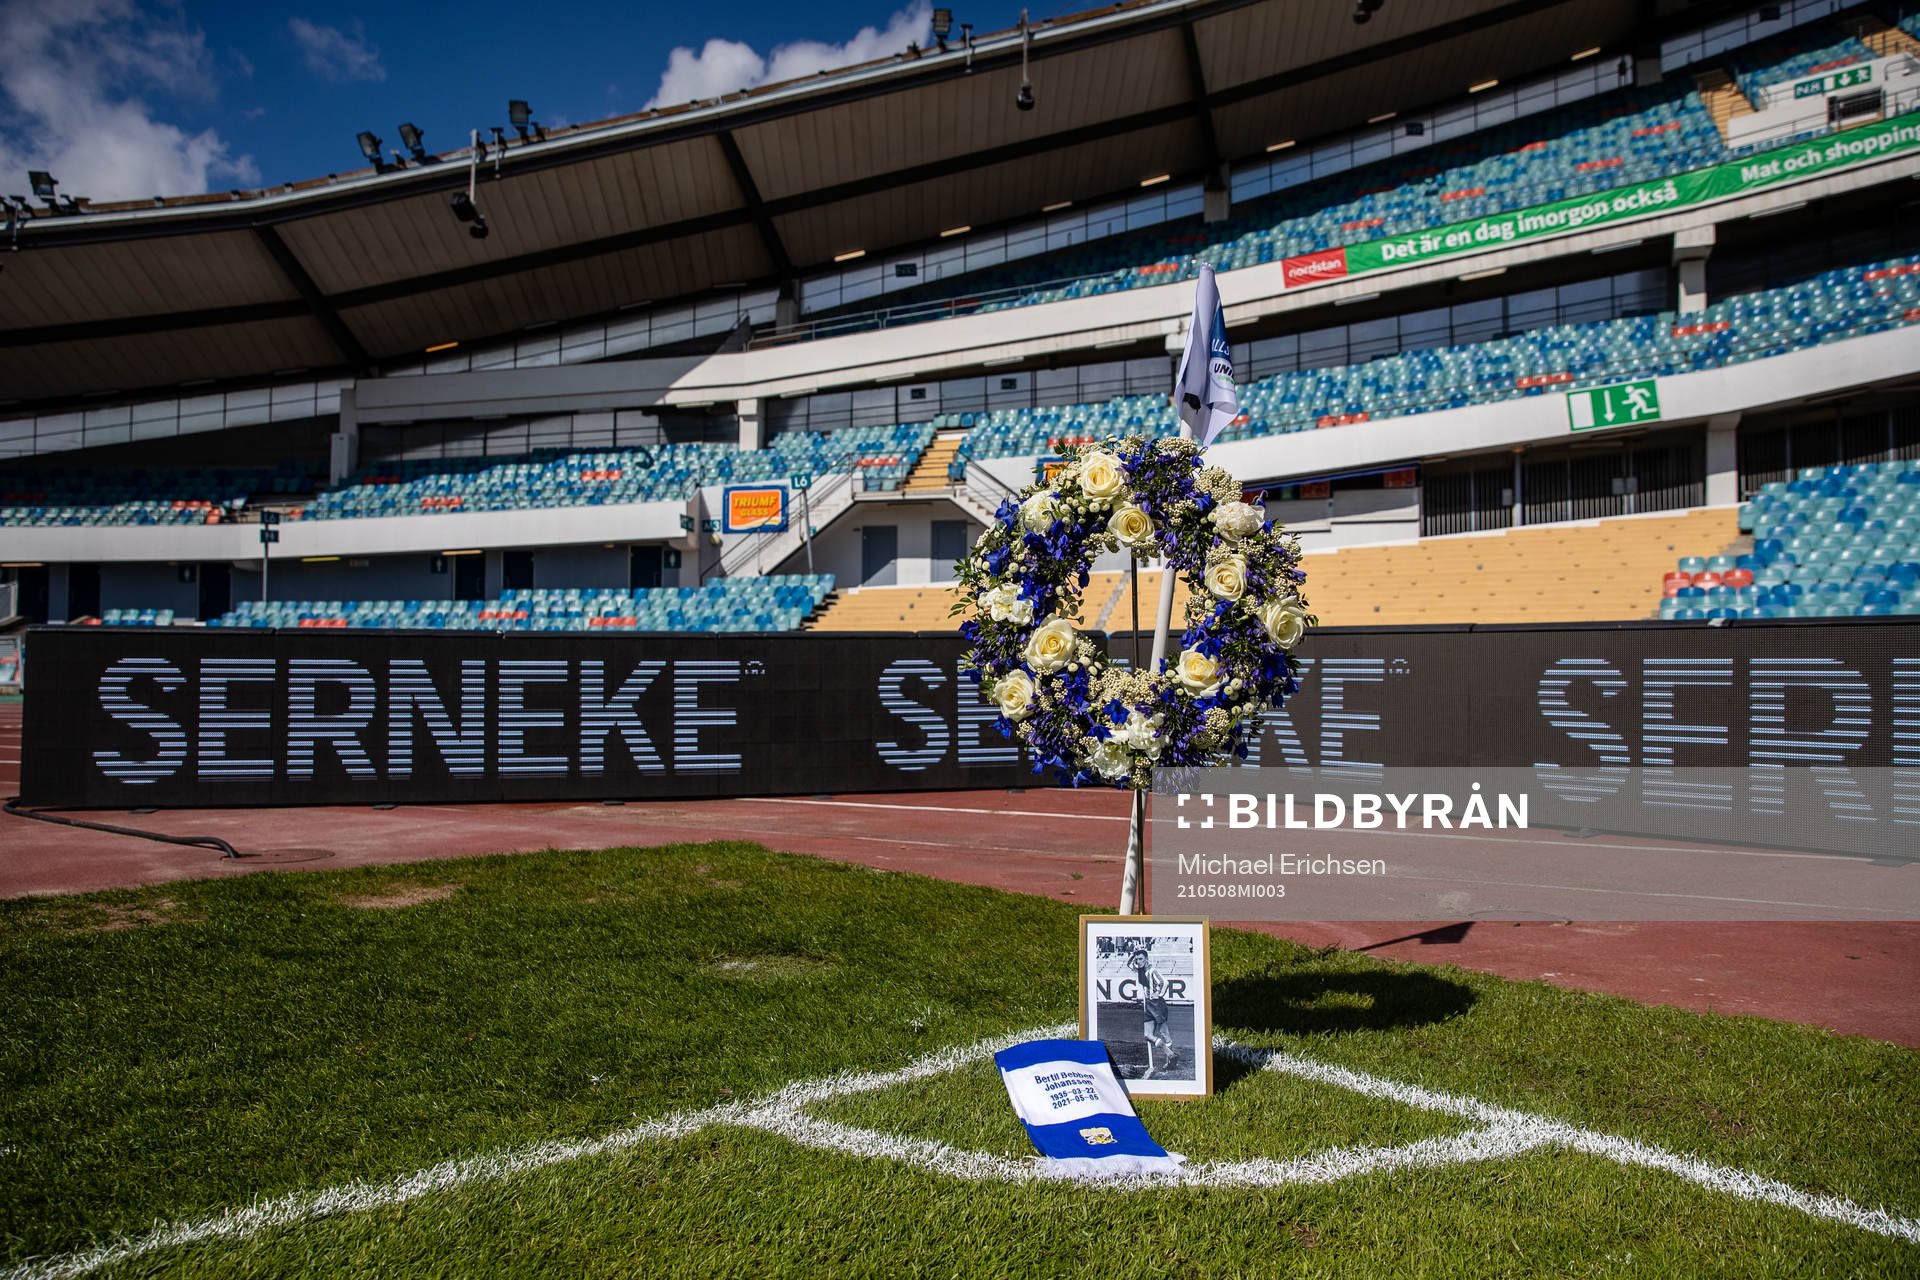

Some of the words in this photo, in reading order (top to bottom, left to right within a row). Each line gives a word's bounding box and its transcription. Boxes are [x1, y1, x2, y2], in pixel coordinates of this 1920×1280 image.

[1741, 159, 1781, 182] Mat
[1784, 150, 1823, 171] och
[1381, 242, 1416, 261] Det
[1420, 233, 1442, 253] är
[1446, 229, 1471, 247] en
[1475, 221, 1516, 241] dag
[1517, 200, 1609, 233] imorgon
[1613, 180, 1679, 212] också
[1288, 258, 1342, 278] nordstan
[794, 476, 809, 488] L6
[733, 495, 777, 508] TRIUMF
[740, 508, 769, 517] GLASS
[93, 657, 742, 785] SERNEKE
[1533, 657, 1920, 824] SER
[1034, 1072, 1060, 1084] Bertil
[1044, 1079, 1093, 1092] Johansson
[1050, 1087, 1096, 1101] 1935-03-22
[1052, 1094, 1099, 1109] 2021-05-05
